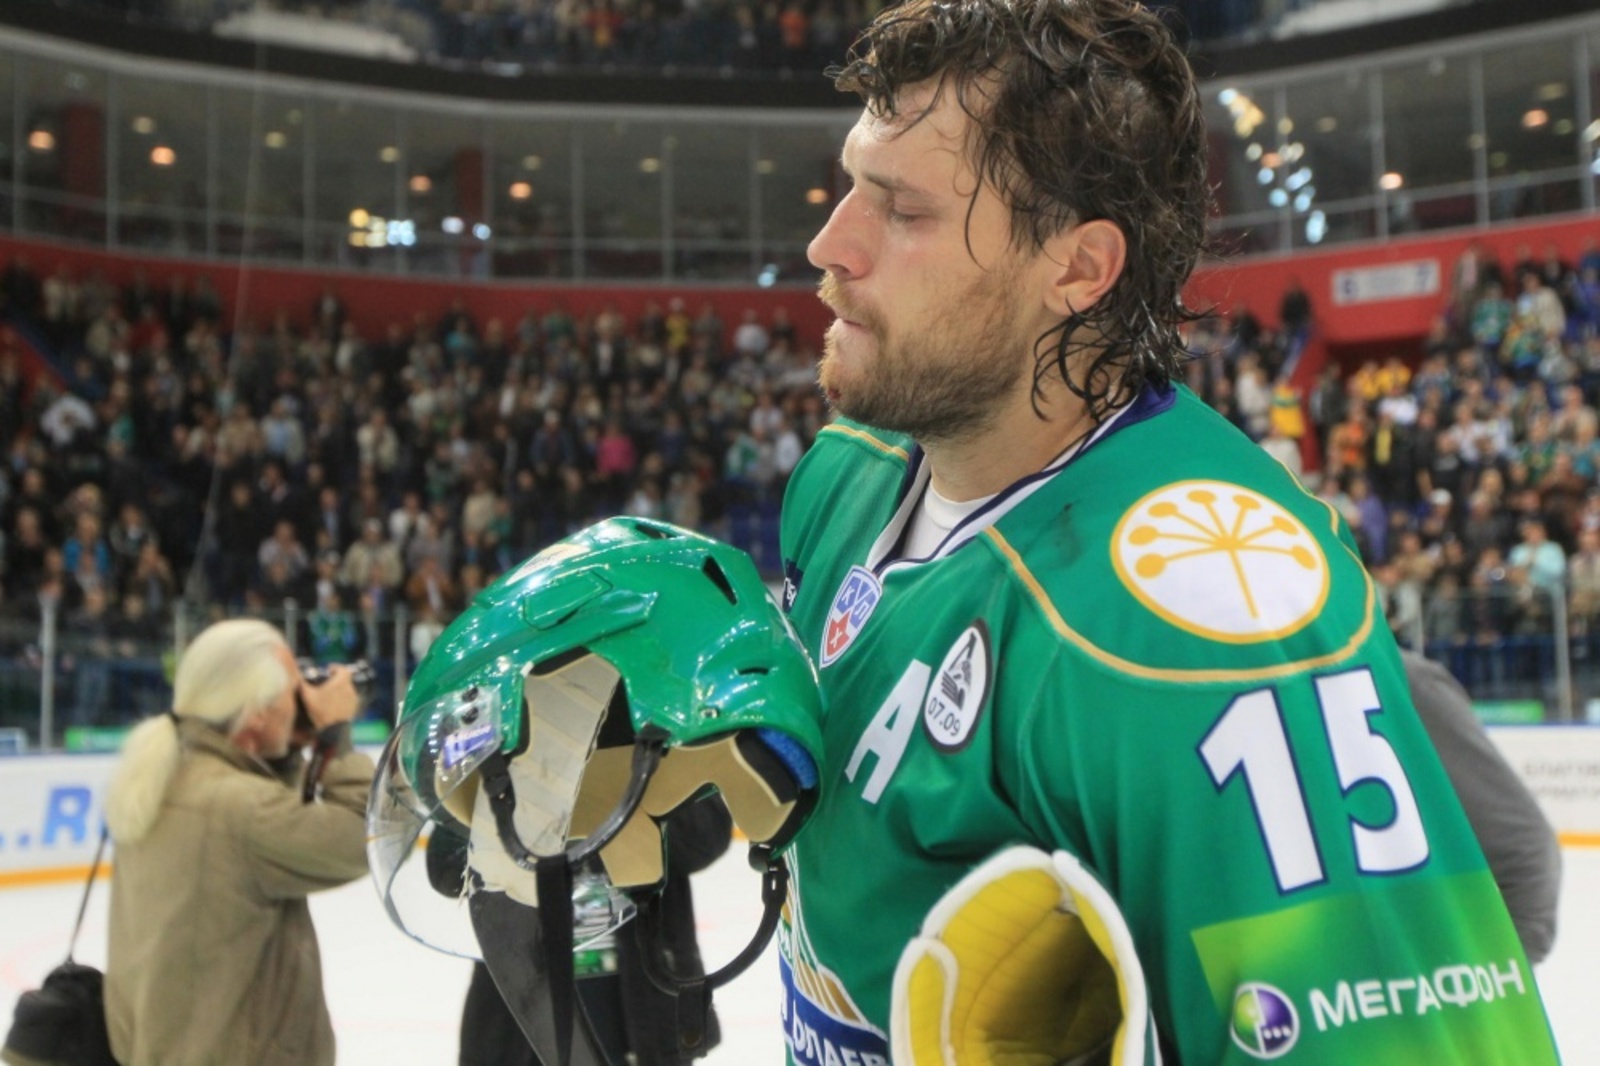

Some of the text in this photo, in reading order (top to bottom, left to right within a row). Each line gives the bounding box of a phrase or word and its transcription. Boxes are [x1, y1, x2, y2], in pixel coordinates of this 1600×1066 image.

[928, 697, 961, 737] 07.09
[1195, 664, 1431, 897] 15
[1309, 958, 1526, 1032] МЕГАФОН
